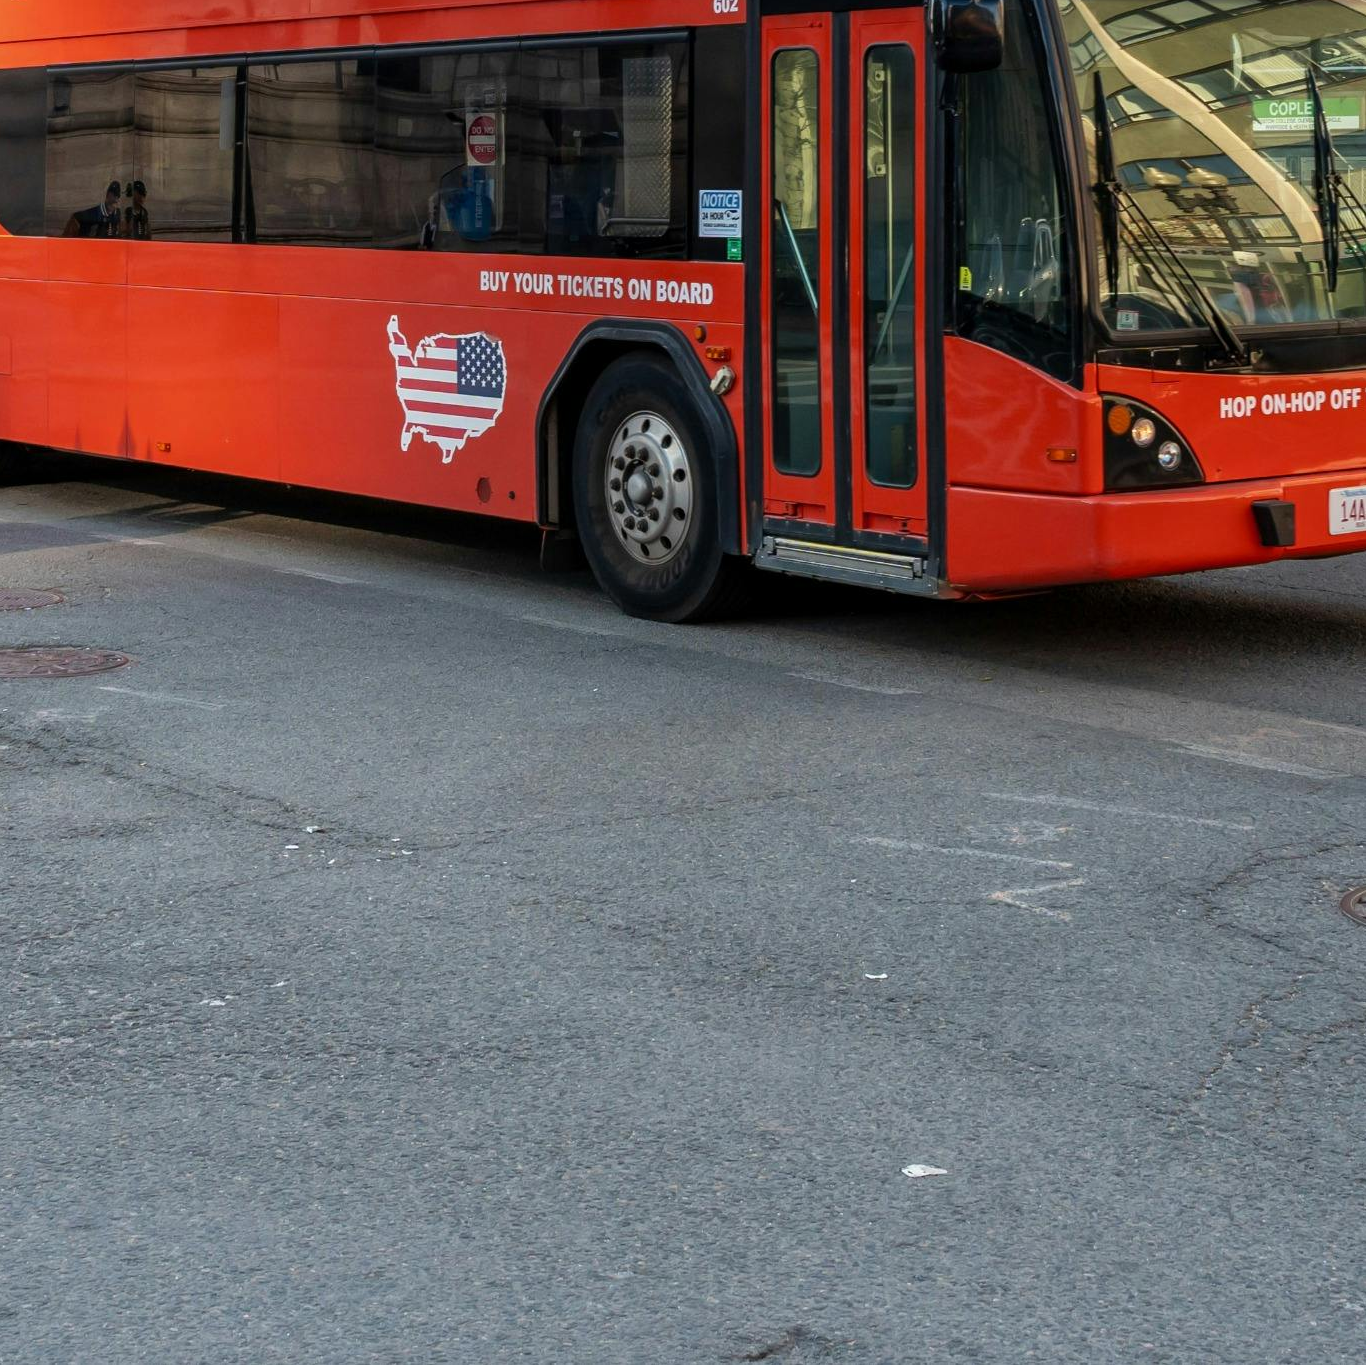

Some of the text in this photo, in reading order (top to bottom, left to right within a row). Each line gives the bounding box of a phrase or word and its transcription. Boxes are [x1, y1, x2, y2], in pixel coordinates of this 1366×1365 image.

[1269, 102, 1314, 116] COPLE
[702, 194, 738, 208] NOTICE
[701, 212, 724, 220] 24 HOUR
[480, 271, 714, 305] BUY YOUR TICKETS ON BOARD
[1220, 396, 1256, 419] HOP
[1260, 391, 1326, 415] ON-HOP
[1330, 388, 1362, 409] OFF
